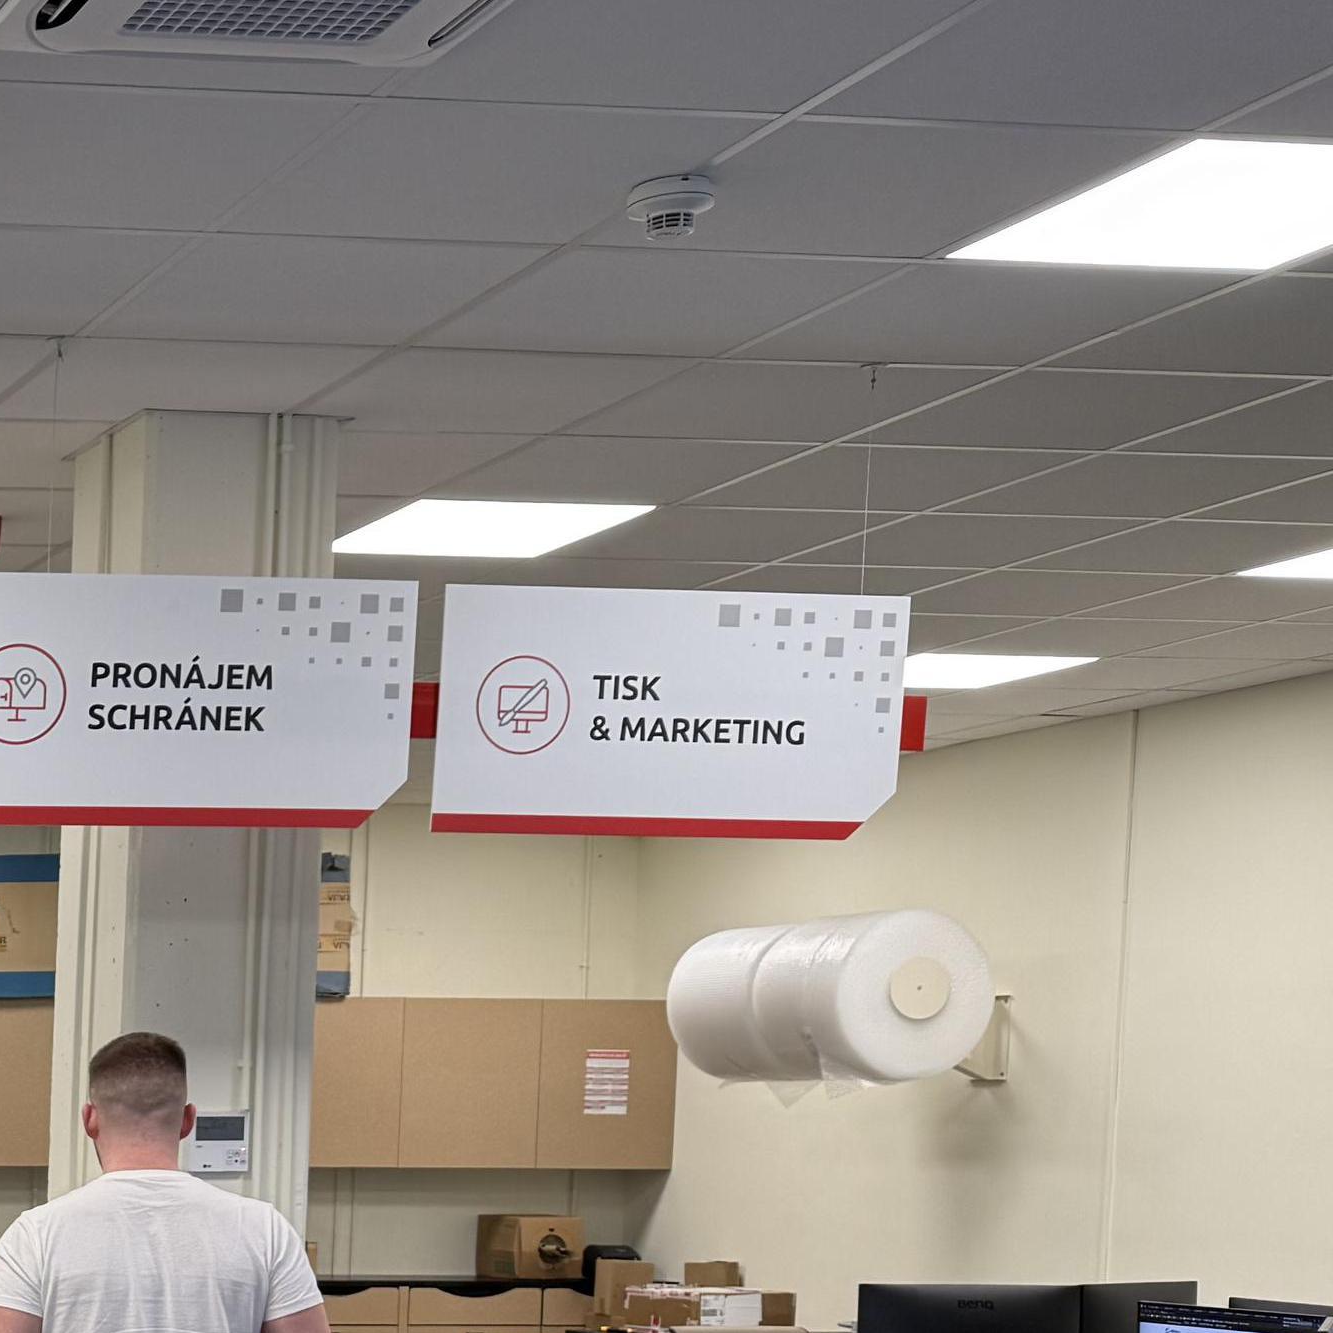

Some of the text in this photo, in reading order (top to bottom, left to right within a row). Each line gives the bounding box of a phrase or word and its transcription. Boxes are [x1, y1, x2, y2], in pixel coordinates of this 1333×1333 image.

[90, 655, 273, 690] PRONÁJEM
[592, 674, 661, 701] TISK
[87, 697, 266, 732] SCHRÁNEK
[589, 715, 806, 746] & MARKETING
